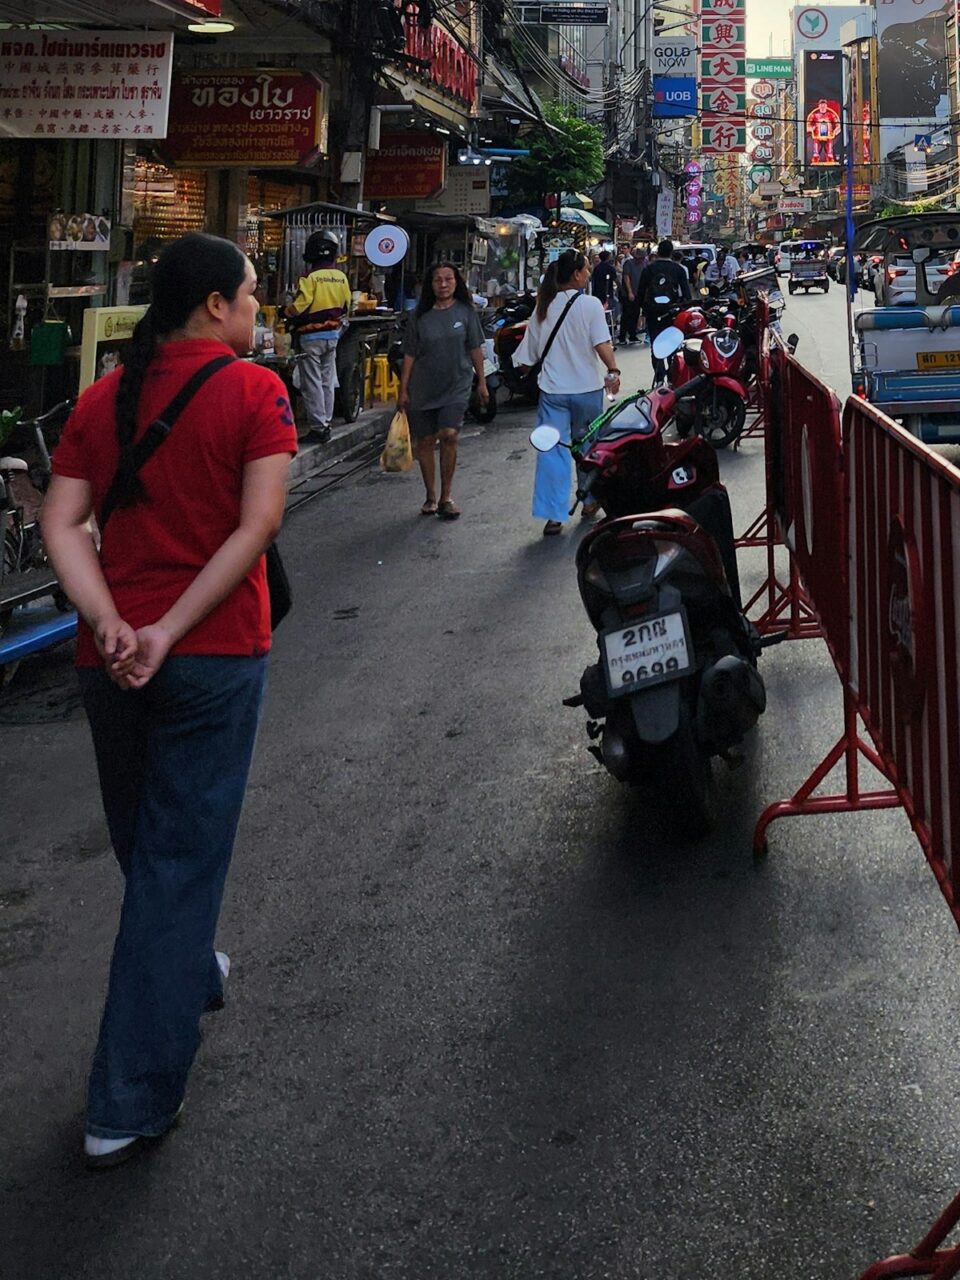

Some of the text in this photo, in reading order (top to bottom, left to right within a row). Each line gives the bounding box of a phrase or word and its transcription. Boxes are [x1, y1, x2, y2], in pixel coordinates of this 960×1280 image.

[654, 46, 690, 58] GOLD
[658, 57, 687, 67] NOW
[191, 73, 294, 108] ทองใบ
[666, 91, 691, 101] UOB
[249, 106, 312, 121] เยาวราช
